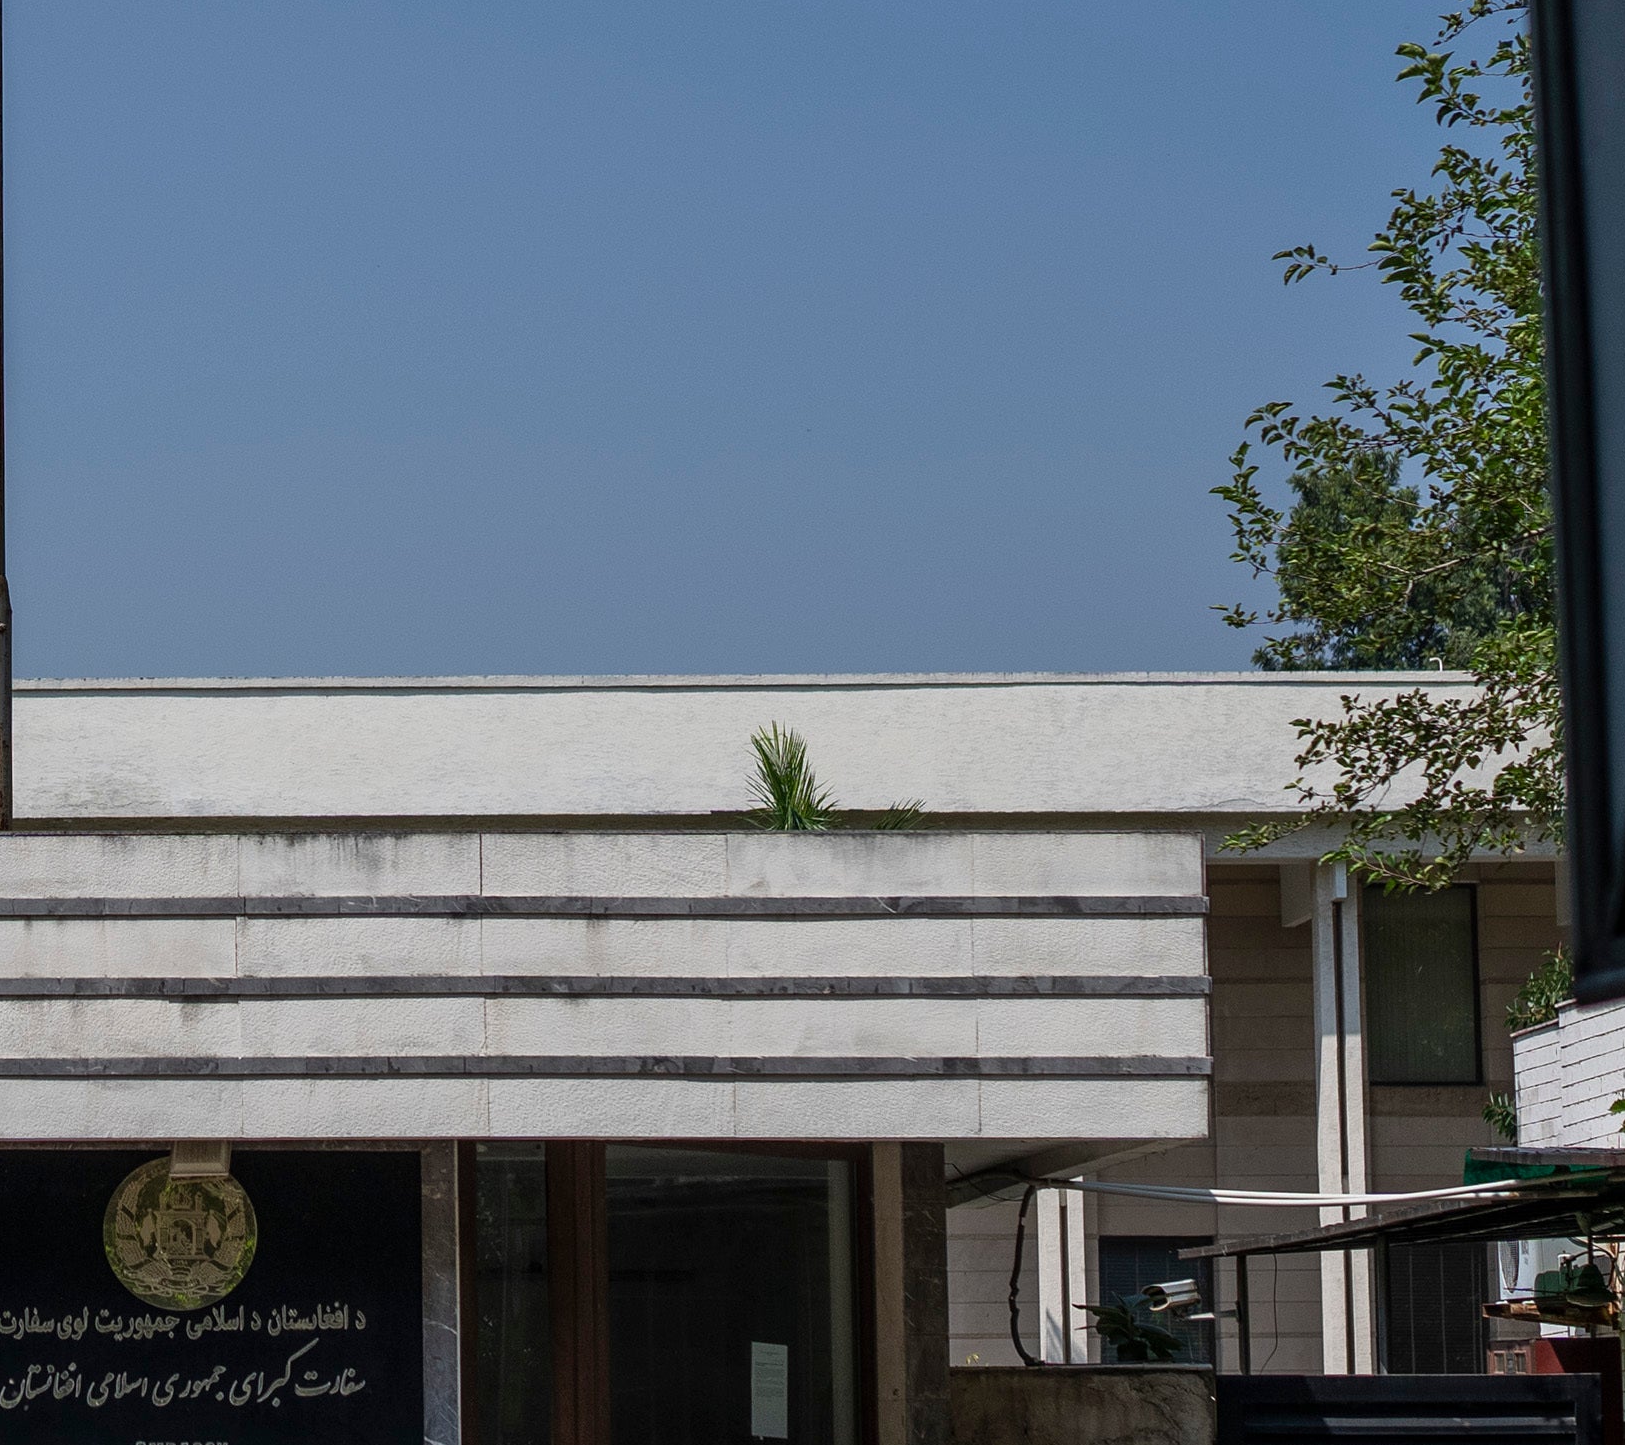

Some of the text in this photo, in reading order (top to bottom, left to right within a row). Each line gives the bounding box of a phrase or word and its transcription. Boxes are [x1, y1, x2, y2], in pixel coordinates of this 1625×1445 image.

[250, 1310, 262, 1331] د
[355, 1309, 367, 1331] د
[0, 1362, 82, 1409] افغانستان
[152, 1364, 227, 1407] جمهوری
[294, 1367, 367, 1397] سفارت
